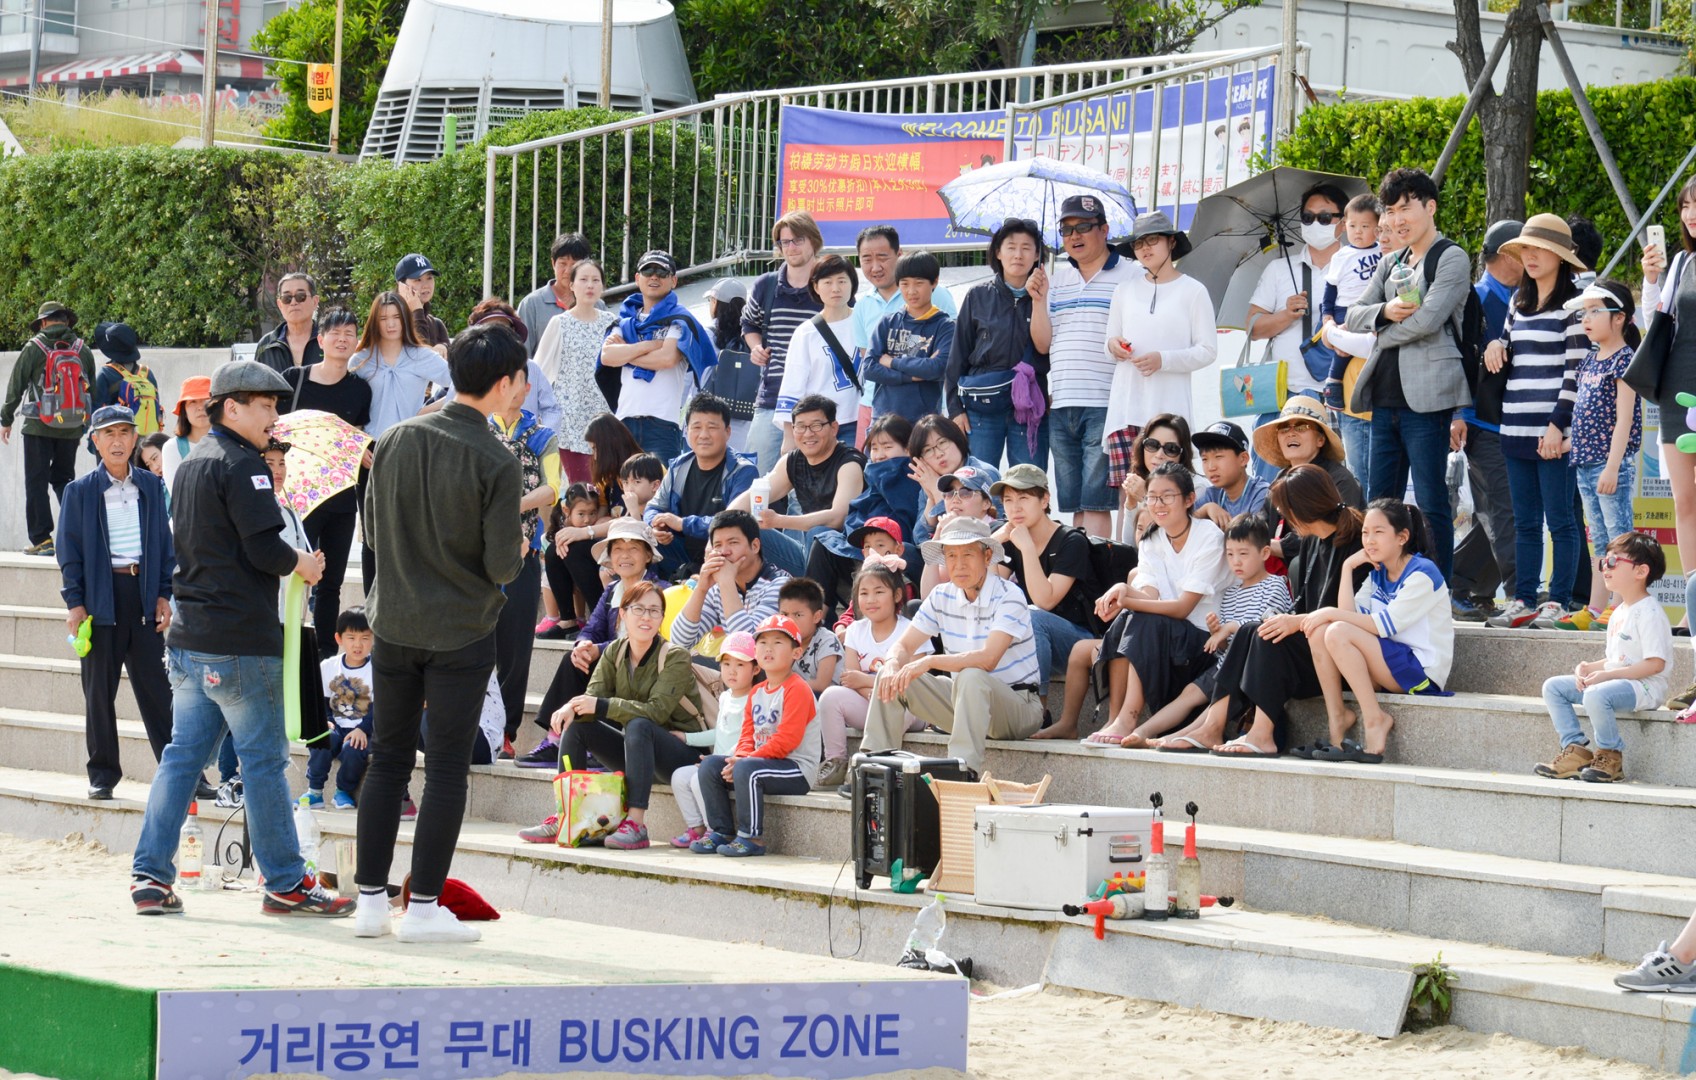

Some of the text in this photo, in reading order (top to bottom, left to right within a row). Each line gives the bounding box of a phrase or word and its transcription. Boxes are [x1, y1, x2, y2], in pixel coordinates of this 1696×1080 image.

[1247, 78, 1268, 101] LFE
[1052, 101, 1127, 136] BUSAN!
[1358, 252, 1383, 270] KIN
[240, 1013, 901, 1073] 거리공연 무대 BUSKING ZONE
